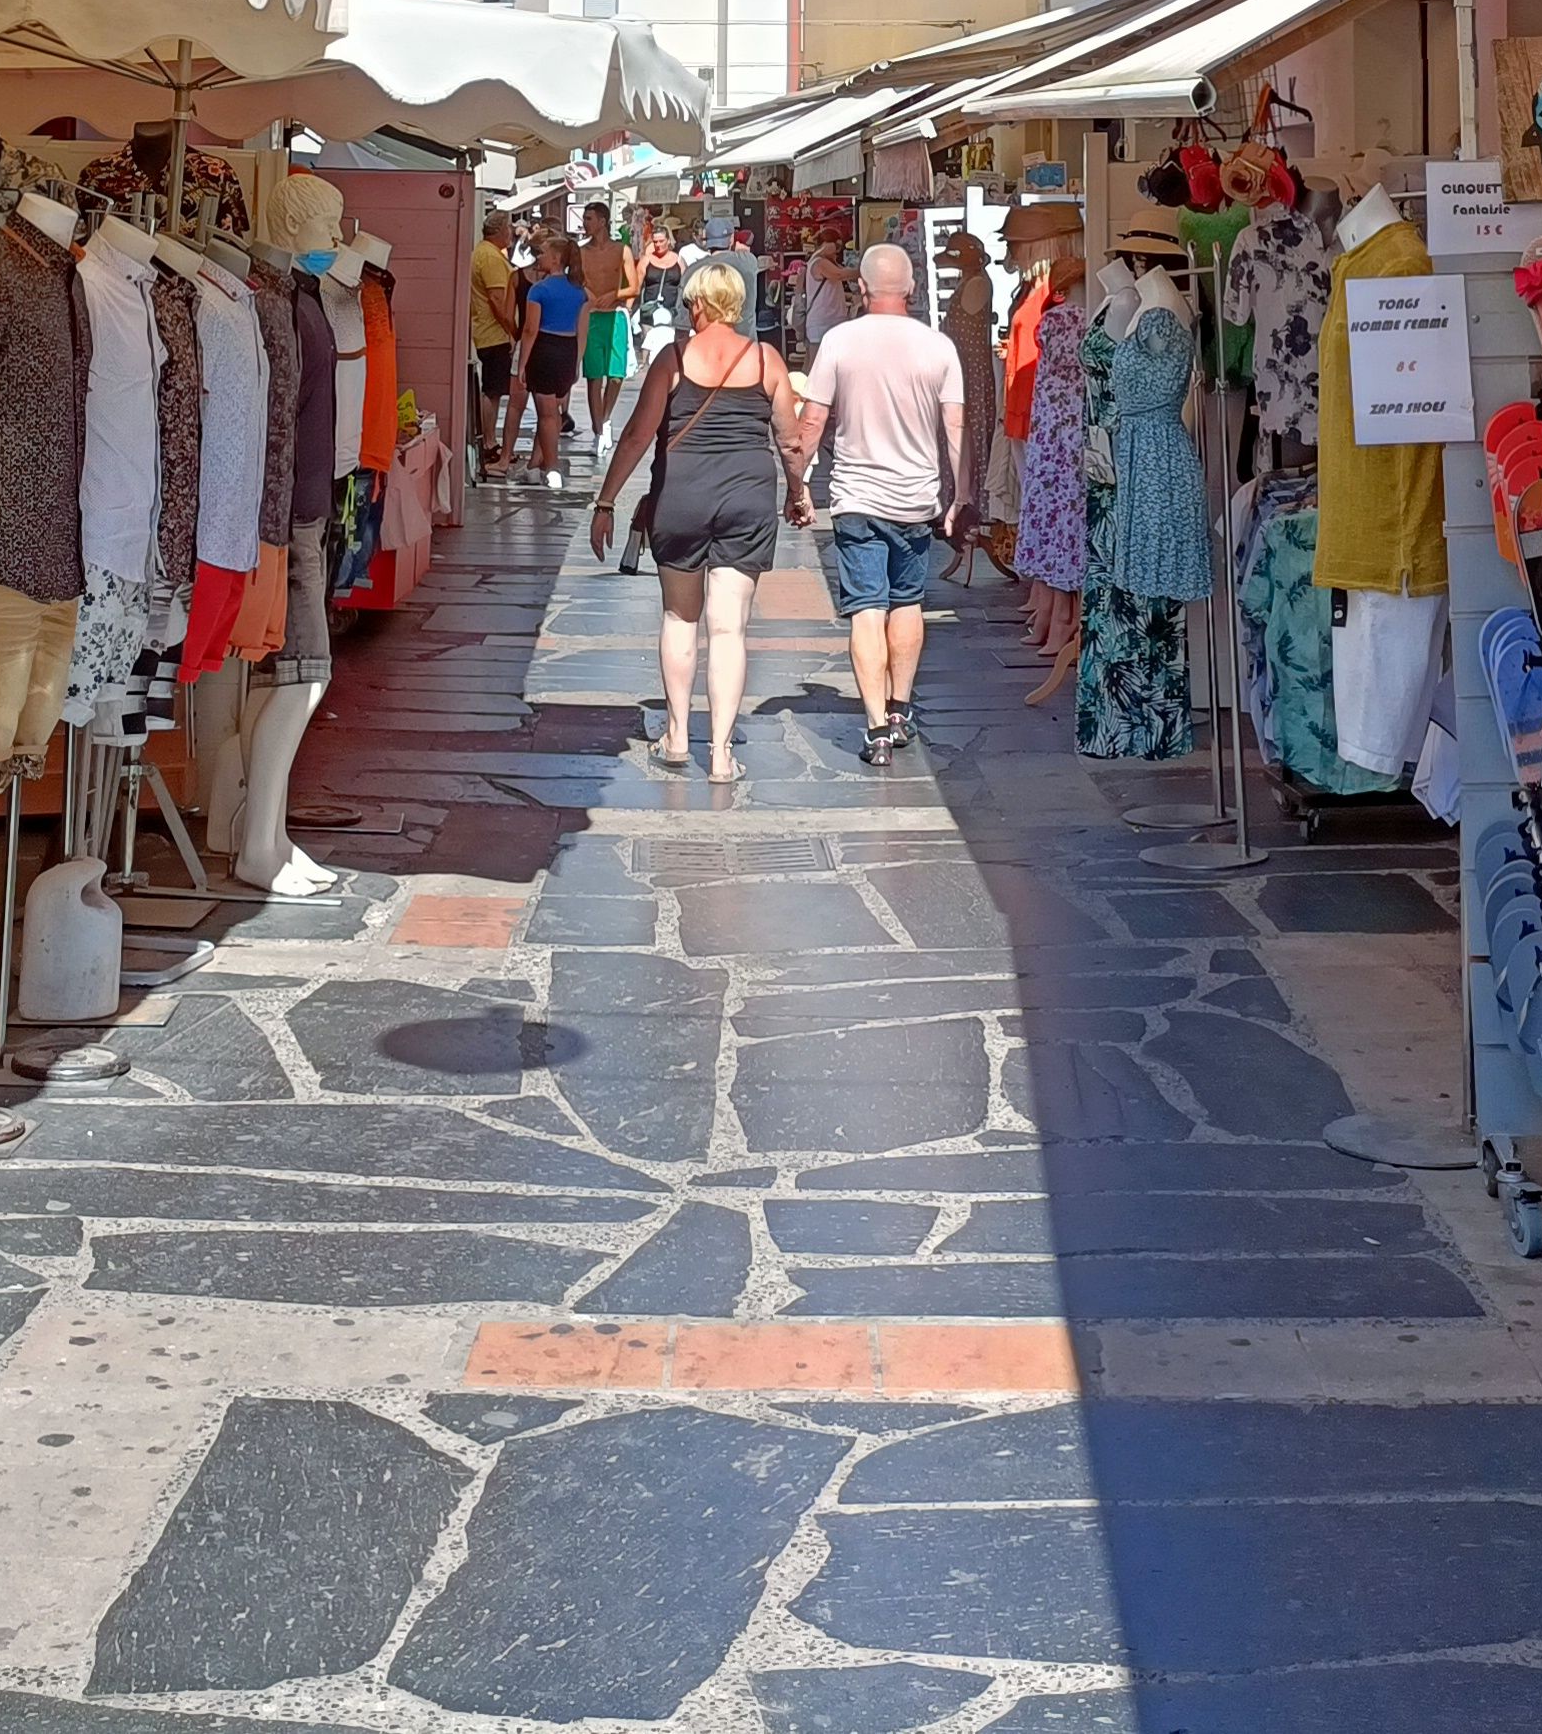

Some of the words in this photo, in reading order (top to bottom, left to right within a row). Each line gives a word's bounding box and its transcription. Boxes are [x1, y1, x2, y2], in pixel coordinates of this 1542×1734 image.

[1453, 203, 1511, 216] Fantaisie
[1350, 319, 1401, 332] HOMME
[1403, 317, 1449, 330] FEMME
[1370, 402, 1403, 415] ZAPA
[1405, 401, 1446, 414] SHOES
